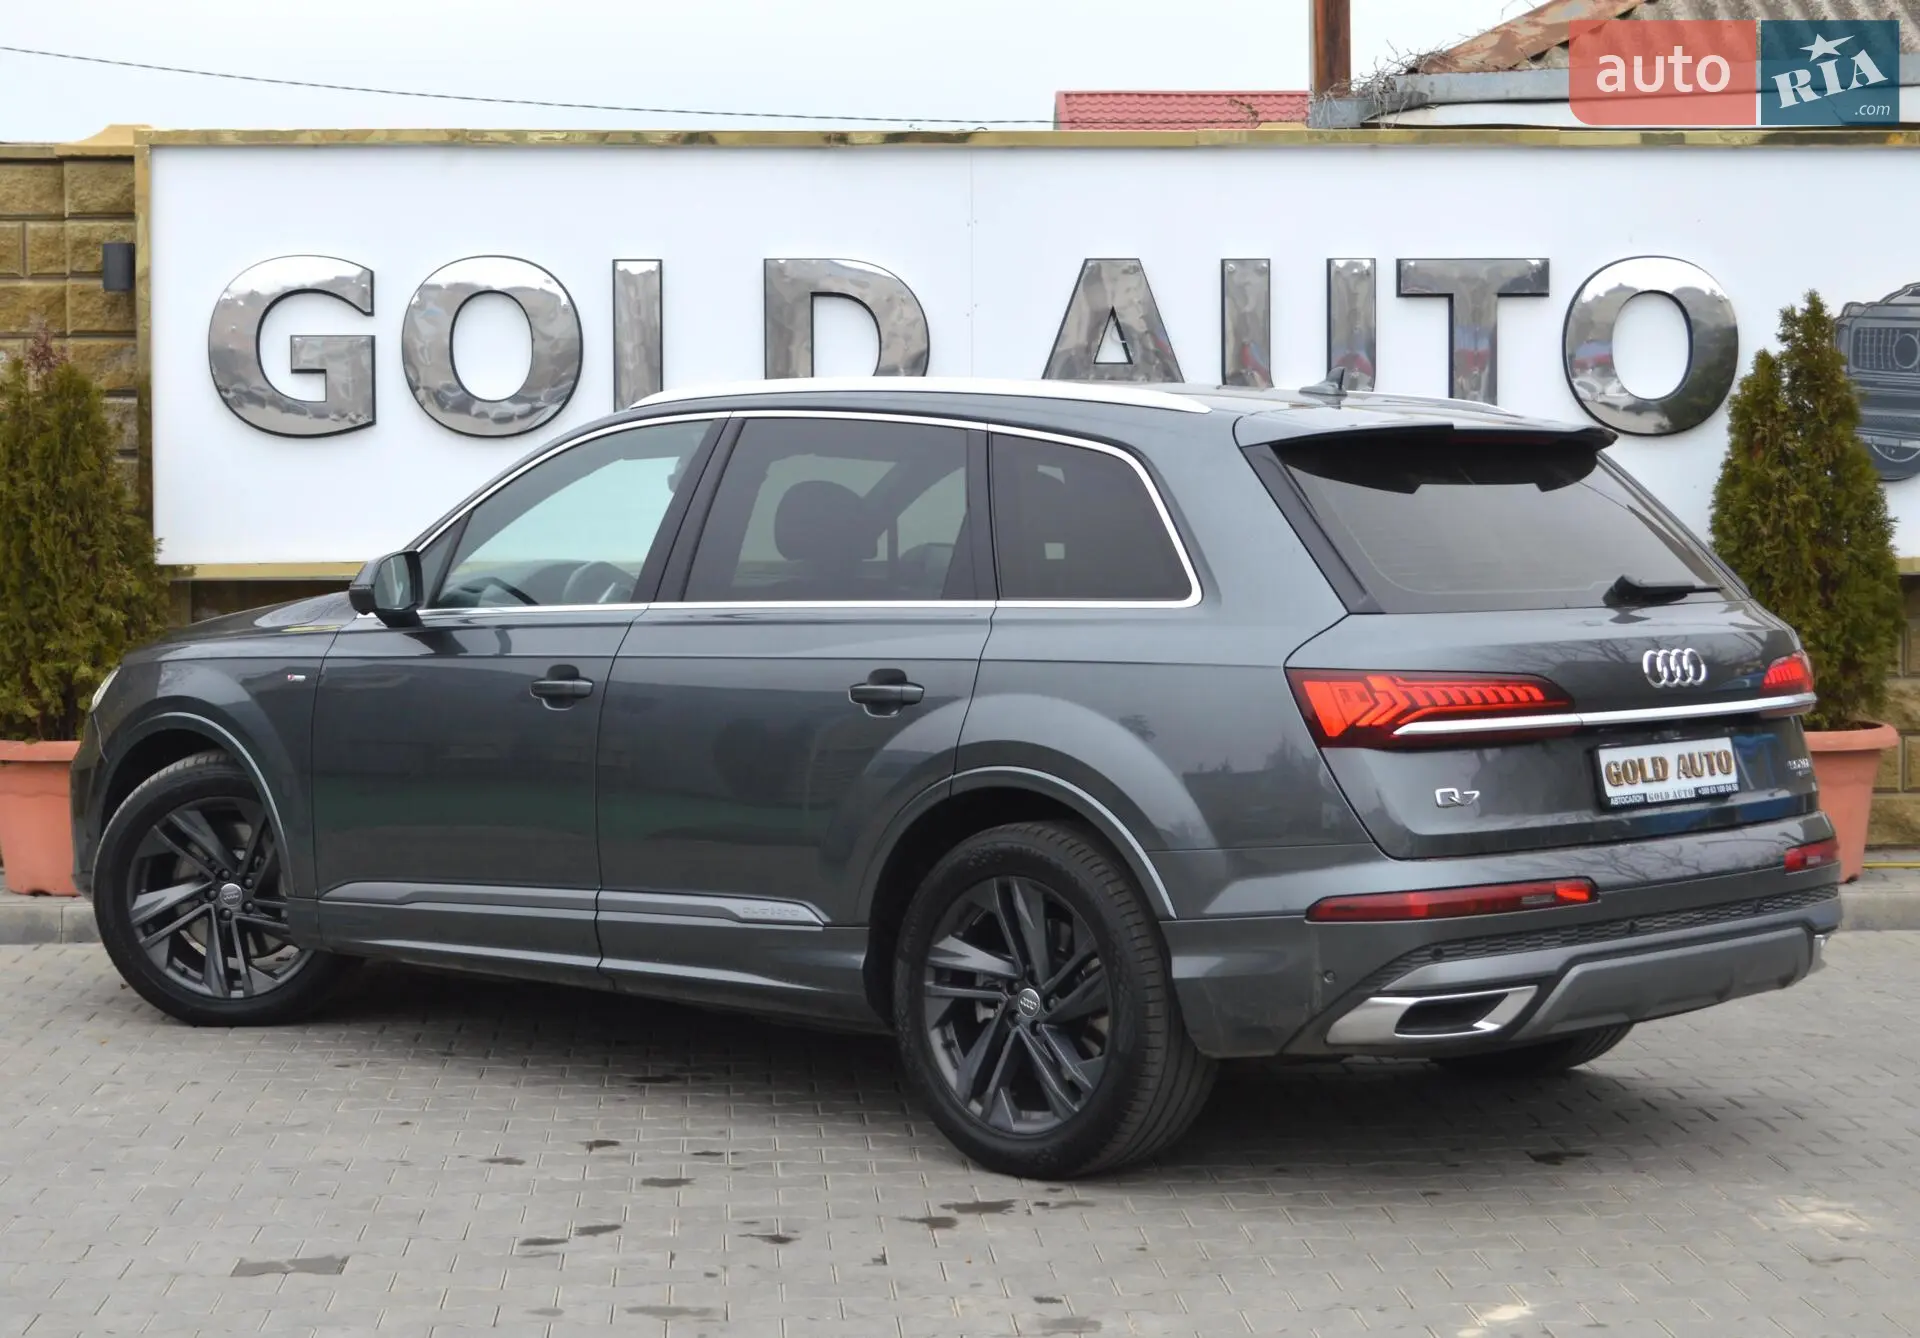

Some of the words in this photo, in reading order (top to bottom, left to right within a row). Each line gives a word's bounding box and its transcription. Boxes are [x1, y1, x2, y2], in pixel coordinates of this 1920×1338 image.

[208, 254, 930, 438] GOLD
[1041, 254, 1740, 438] AUTO
[1604, 755, 1669, 787] GOLD
[1677, 749, 1733, 779] AUTO
[1434, 787, 1480, 808] Q7
